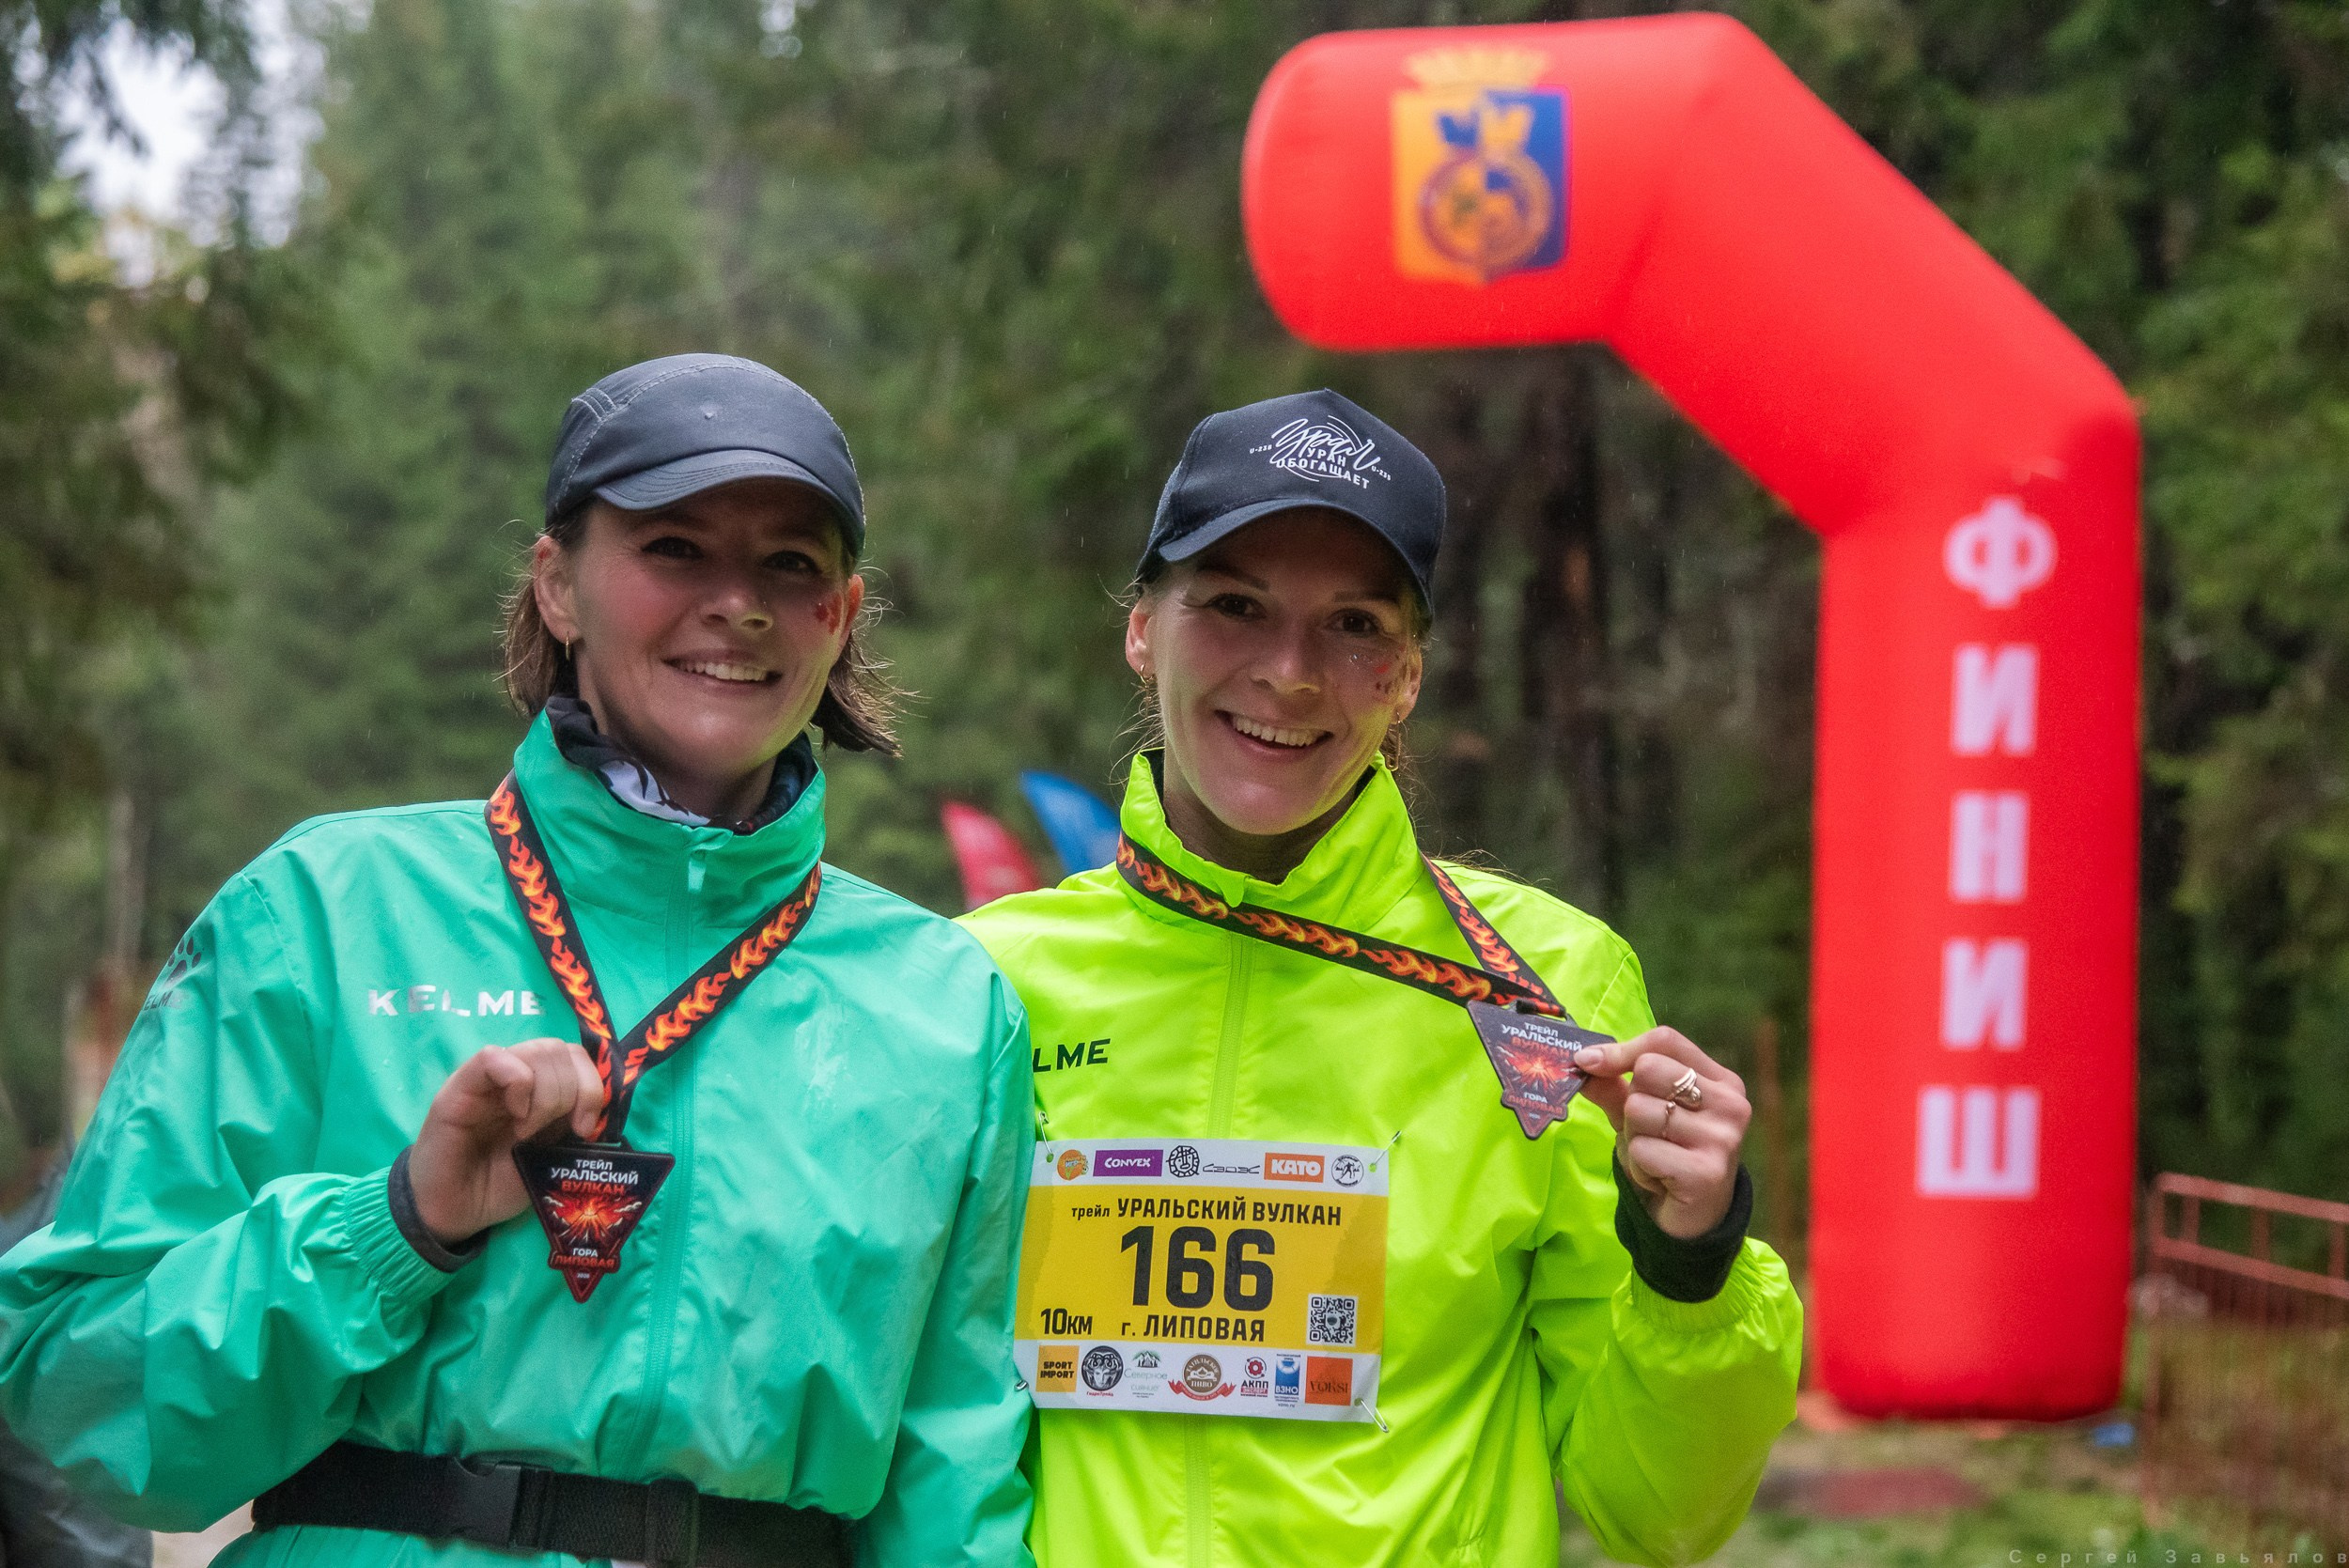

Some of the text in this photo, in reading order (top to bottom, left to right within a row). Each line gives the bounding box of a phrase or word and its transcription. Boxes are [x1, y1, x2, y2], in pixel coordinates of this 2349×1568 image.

[1307, 448, 1346, 467] УРАН
[1276, 458, 1370, 489] ОБОГАЩАЕТ
[1914, 494, 2060, 1200] ФИНИШ
[368, 985, 544, 1017] KELME
[1501, 1024, 1583, 1052] УРАЛЬСКИЙ
[1524, 1022, 1559, 1037] ТРЕЙЛ
[1033, 1038, 1111, 1073] LME
[1523, 1092, 1548, 1104] ГОРА
[576, 1159, 613, 1171] ТРЕЙЛ
[1105, 1157, 1151, 1169] CONVEX
[551, 1168, 639, 1185] УРАЛЬСКИЙ
[561, 1180, 626, 1196] ВУЛКАН
[1071, 1196, 1342, 1226] трейл УРАЛЬСКИЙ ВУЛКАН
[572, 1248, 599, 1257] ГОРА
[1121, 1225, 1276, 1312] 166
[1143, 1314, 1265, 1342] ЛИПОВАЯ
[1043, 1360, 1073, 1370] SPORT
[1040, 1371, 1075, 1379] IMPORT
[1241, 1379, 1268, 1389] АКПП
